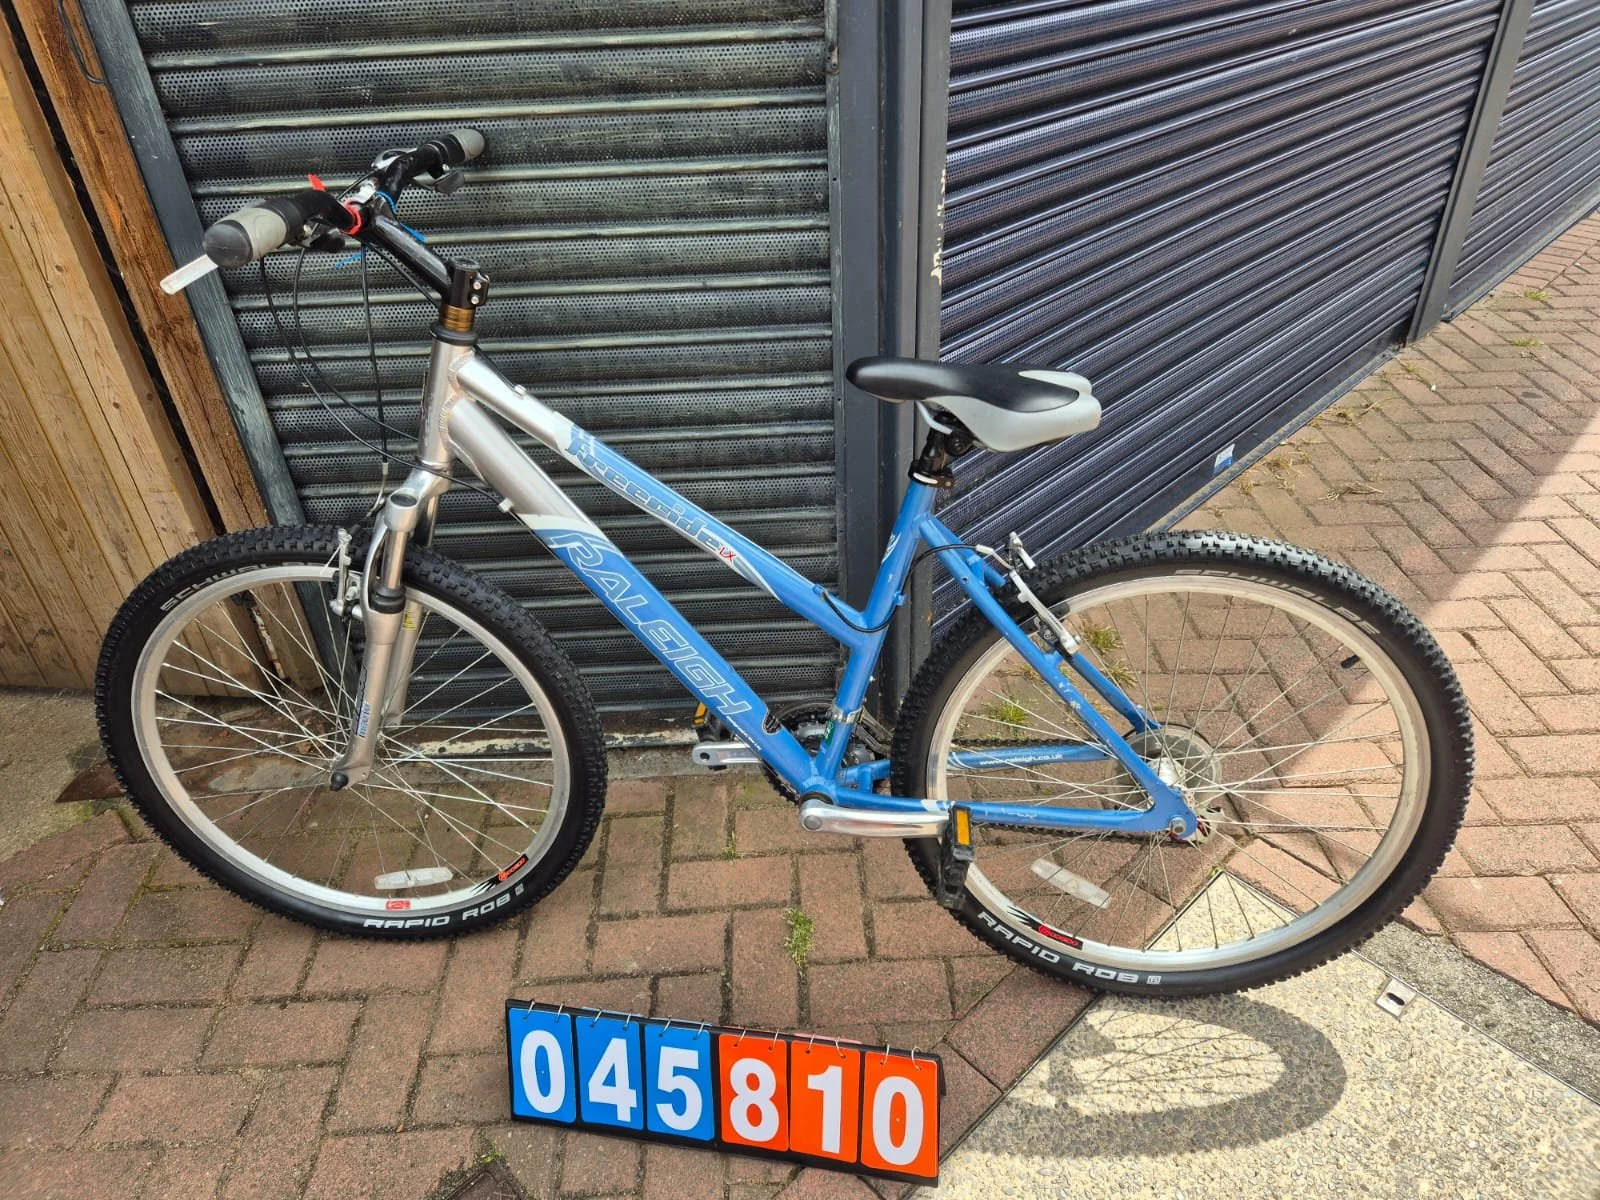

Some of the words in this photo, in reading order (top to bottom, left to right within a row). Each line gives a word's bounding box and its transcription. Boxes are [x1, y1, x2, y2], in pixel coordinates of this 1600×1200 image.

[565, 426, 722, 551] Freeride
[160, 562, 326, 612] SCHWA
[549, 532, 752, 715] RALEIGH
[979, 753, 1063, 766] wwwraleigh.co.uk
[363, 916, 450, 929] RAPID
[462, 894, 511, 921] ROB
[977, 911, 1060, 964] RAPID
[1072, 962, 1138, 984] ROB
